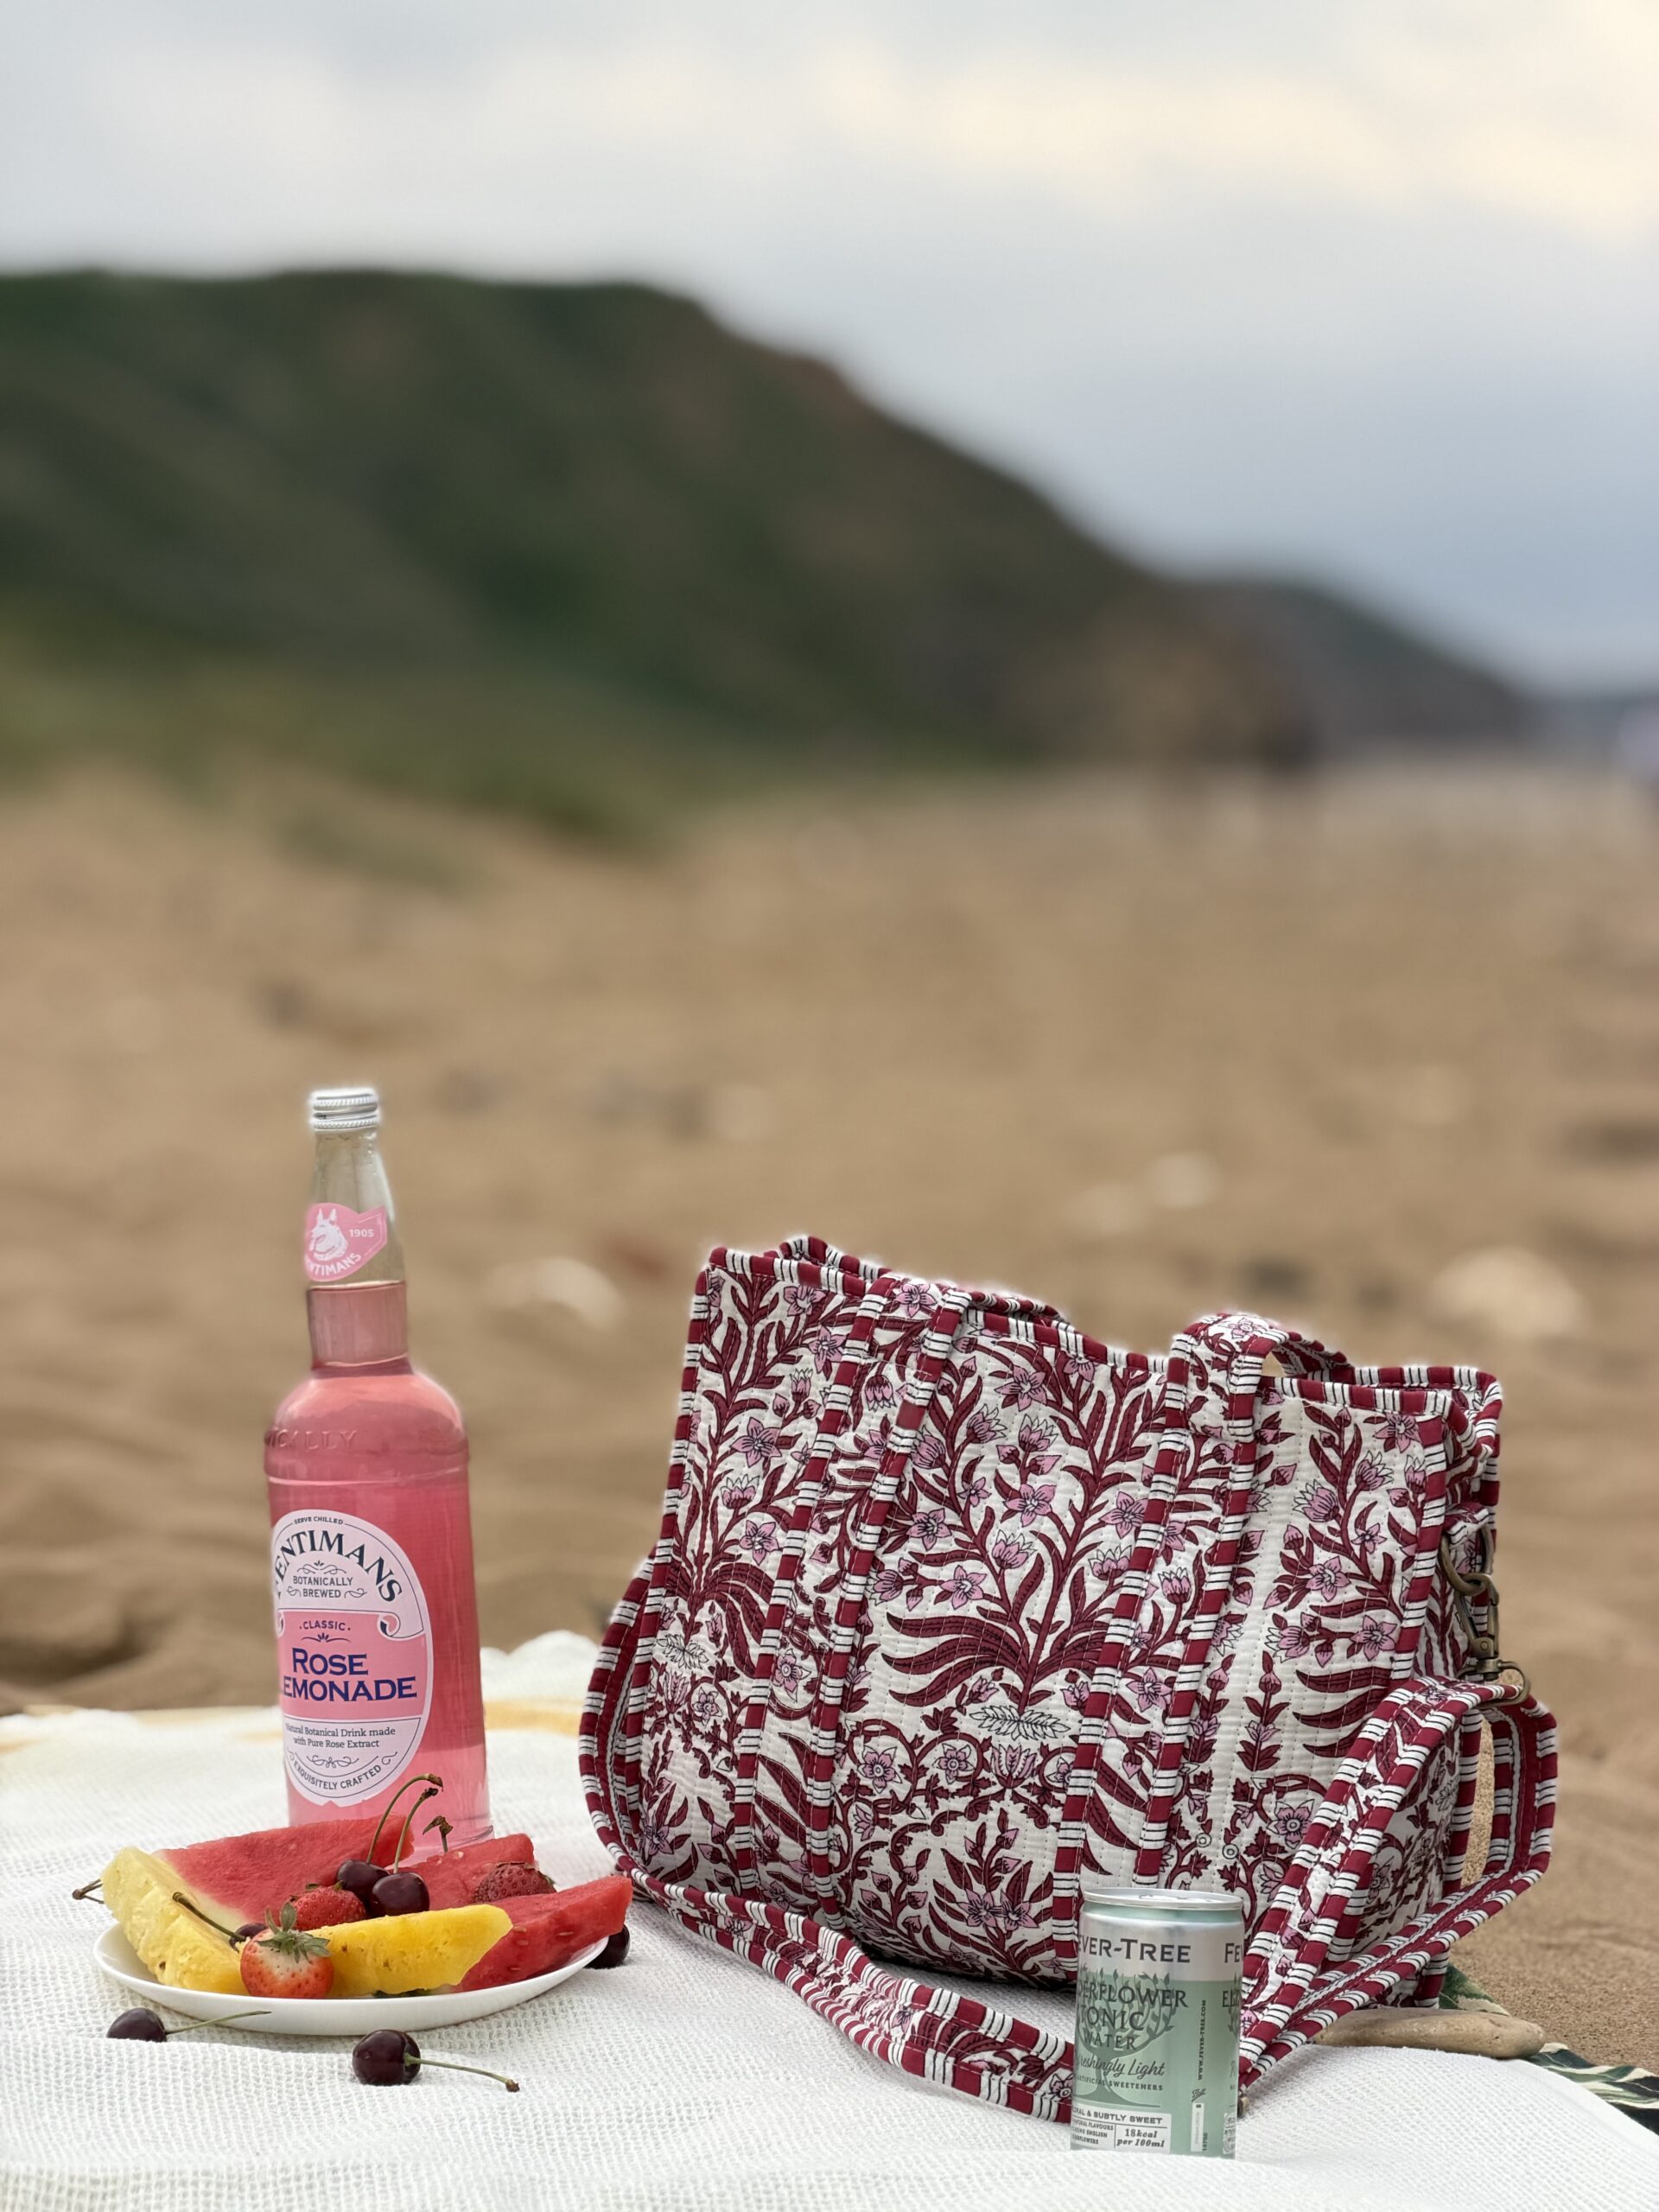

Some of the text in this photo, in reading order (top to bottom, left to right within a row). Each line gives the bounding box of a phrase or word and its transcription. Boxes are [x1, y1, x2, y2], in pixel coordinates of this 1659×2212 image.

[349, 1229, 374, 1238] 1905
[293, 1516, 344, 1525] SERVE CHILLED
[275, 1529, 403, 1602] ENTIMANS
[292, 1575, 353, 1586] BOTANICALLY
[302, 1588, 341, 1599] BREWED
[303, 1620, 346, 1631] CLASSIC
[292, 1647, 369, 1675] ROSE
[283, 1675, 417, 1702] EMONADE
[304, 1726, 339, 1738] Botanical
[340, 1728, 367, 1738] Drink
[369, 1727, 396, 1737] made
[294, 1736, 380, 1749] with Pure Rose Extract
[294, 1761, 382, 1790] EXQUISITELY CRAFTED
[1078, 1935, 1192, 1964] VER-TREE
[1081, 2004, 1144, 2031] TONIC
[1083, 2027, 1137, 2050] WATER
[1127, 2058, 1166, 2080] Light
[1109, 2080, 1163, 2091] SWEETENERS
[1093, 2111, 1127, 2122] SUBTLY
[1129, 2115, 1163, 2125] SWEET
[1088, 2121, 1114, 2131] FLAVOURS
[1125, 2128, 1158, 2139] 18kcal
[1135, 2139, 1165, 2148] 100ml
